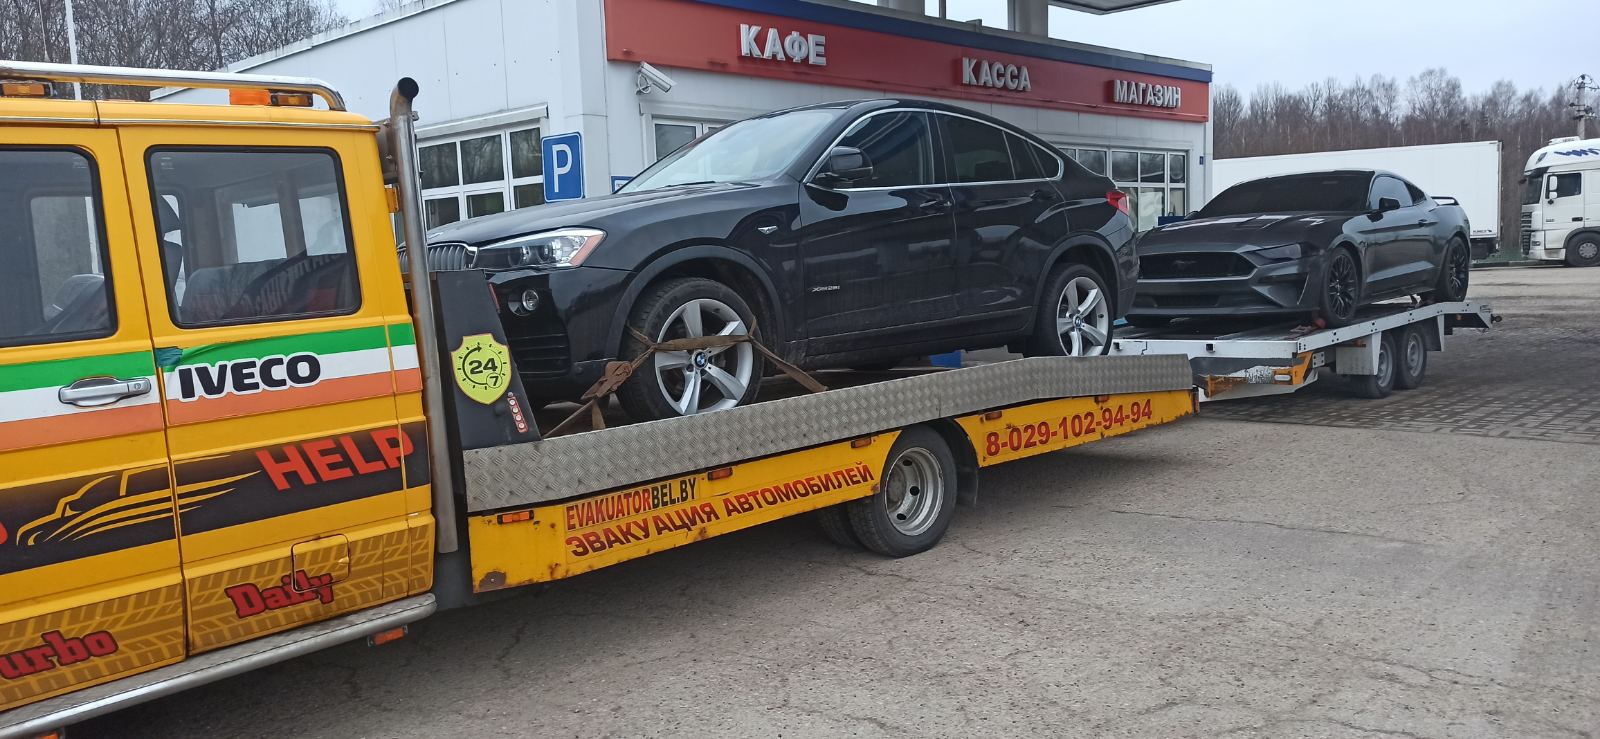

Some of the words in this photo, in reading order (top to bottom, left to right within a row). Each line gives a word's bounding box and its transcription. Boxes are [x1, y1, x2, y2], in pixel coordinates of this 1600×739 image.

[740, 23, 827, 65] КАФЕ
[962, 57, 1031, 91] КАССА
[1114, 79, 1182, 108] МАГАЗИН
[552, 143, 572, 193] P
[178, 354, 321, 399] IVECO
[468, 357, 498, 375] 24
[489, 375, 499, 387] 7
[986, 398, 1153, 457] 8-029-102-94-94
[255, 428, 414, 491] HELP
[565, 477, 697, 531] EVAKUATORBEL.BY
[565, 502, 720, 557] ЭВАКУАЦИЯ
[722, 460, 875, 517] АВТОМОБИЛЕЙ
[225, 569, 334, 618] Daily
